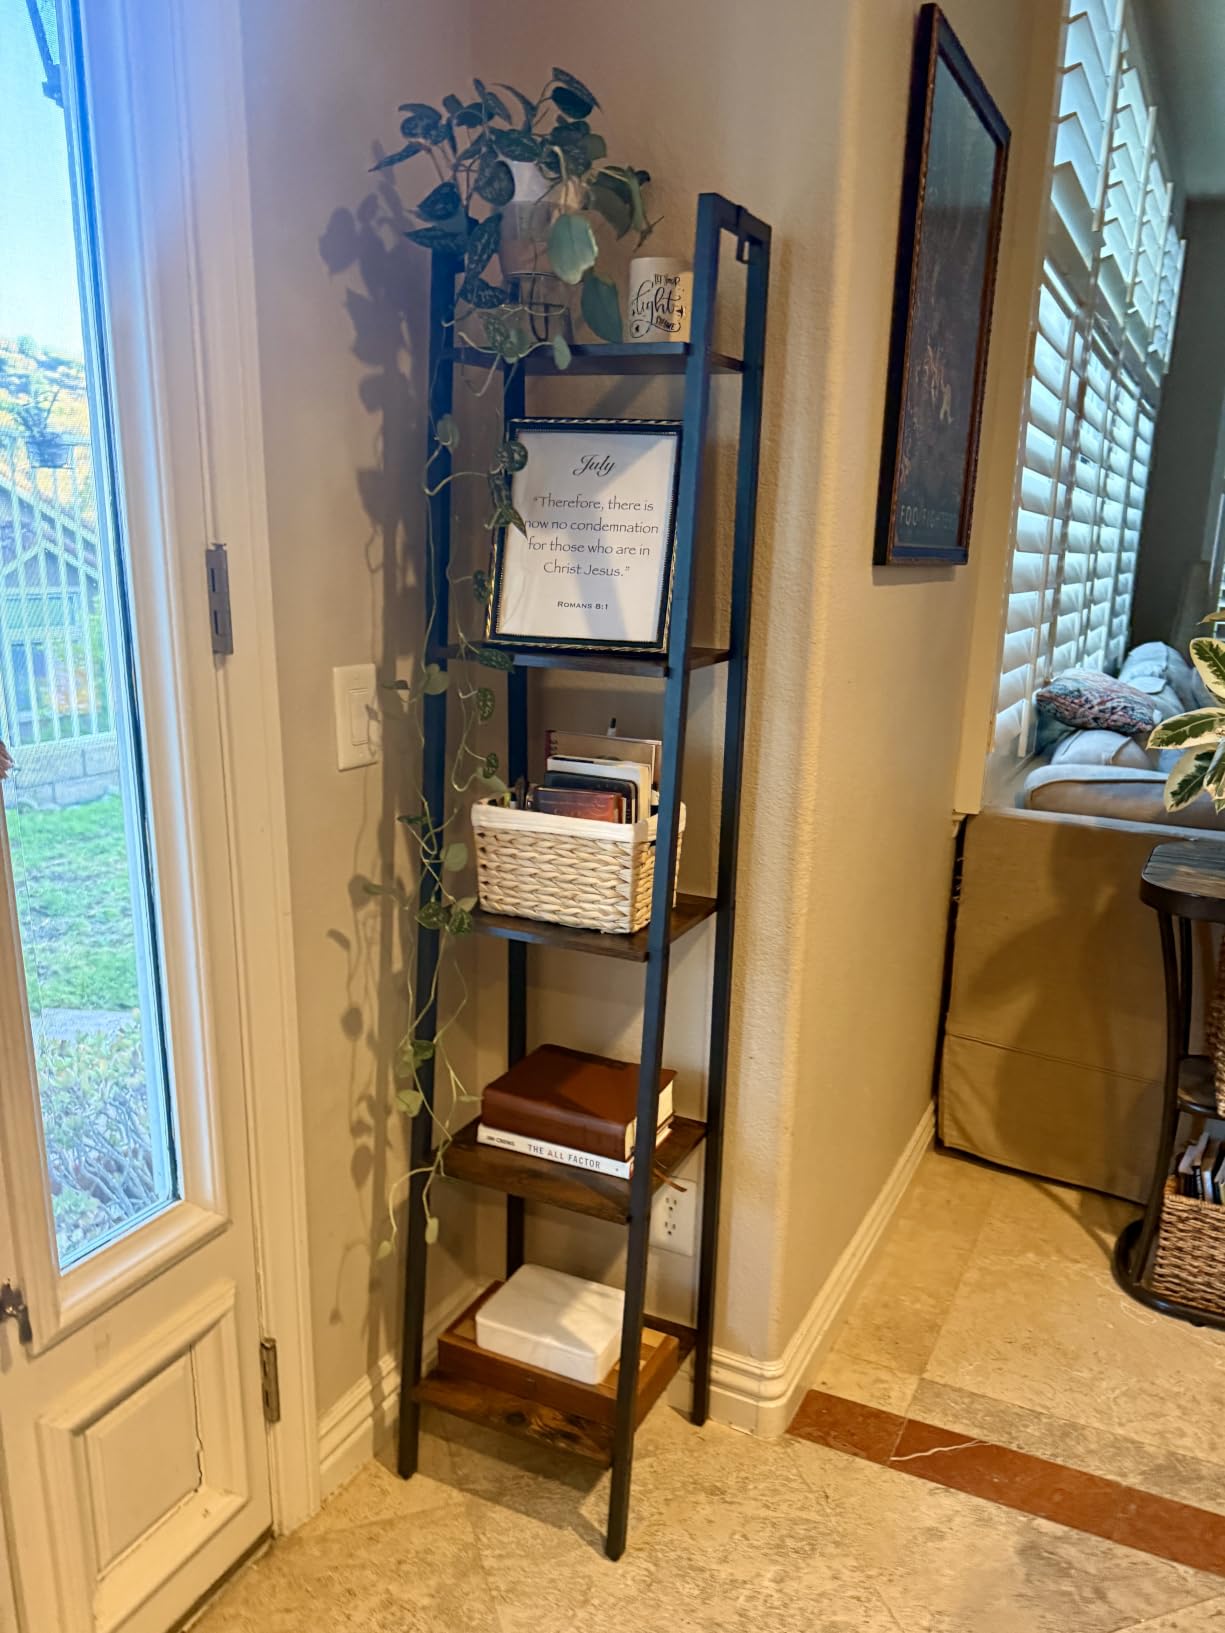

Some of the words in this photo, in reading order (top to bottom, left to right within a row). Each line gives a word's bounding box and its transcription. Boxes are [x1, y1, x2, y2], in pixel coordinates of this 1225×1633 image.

[632, 280, 681, 331] light
[572, 454, 616, 477] July
[608, 497, 641, 512] there
[643, 499, 654, 512] is
[524, 519, 549, 530] now
[551, 521, 568, 530] no
[571, 517, 659, 534] condemnation
[528, 536, 548, 551] for
[550, 536, 585, 553] those
[588, 539, 614, 555] who
[616, 544, 637, 556] are
[639, 544, 650, 556] in
[543, 560, 582, 576] Christ
[582, 563, 631, 577] Jesus."
[557, 600, 593, 610] ROMANS
[595, 601, 609, 610] 8:1
[527, 1144, 544, 1155] THE
[547, 1150, 565, 1160] ALL
[567, 1154, 601, 1169] FACTOR
